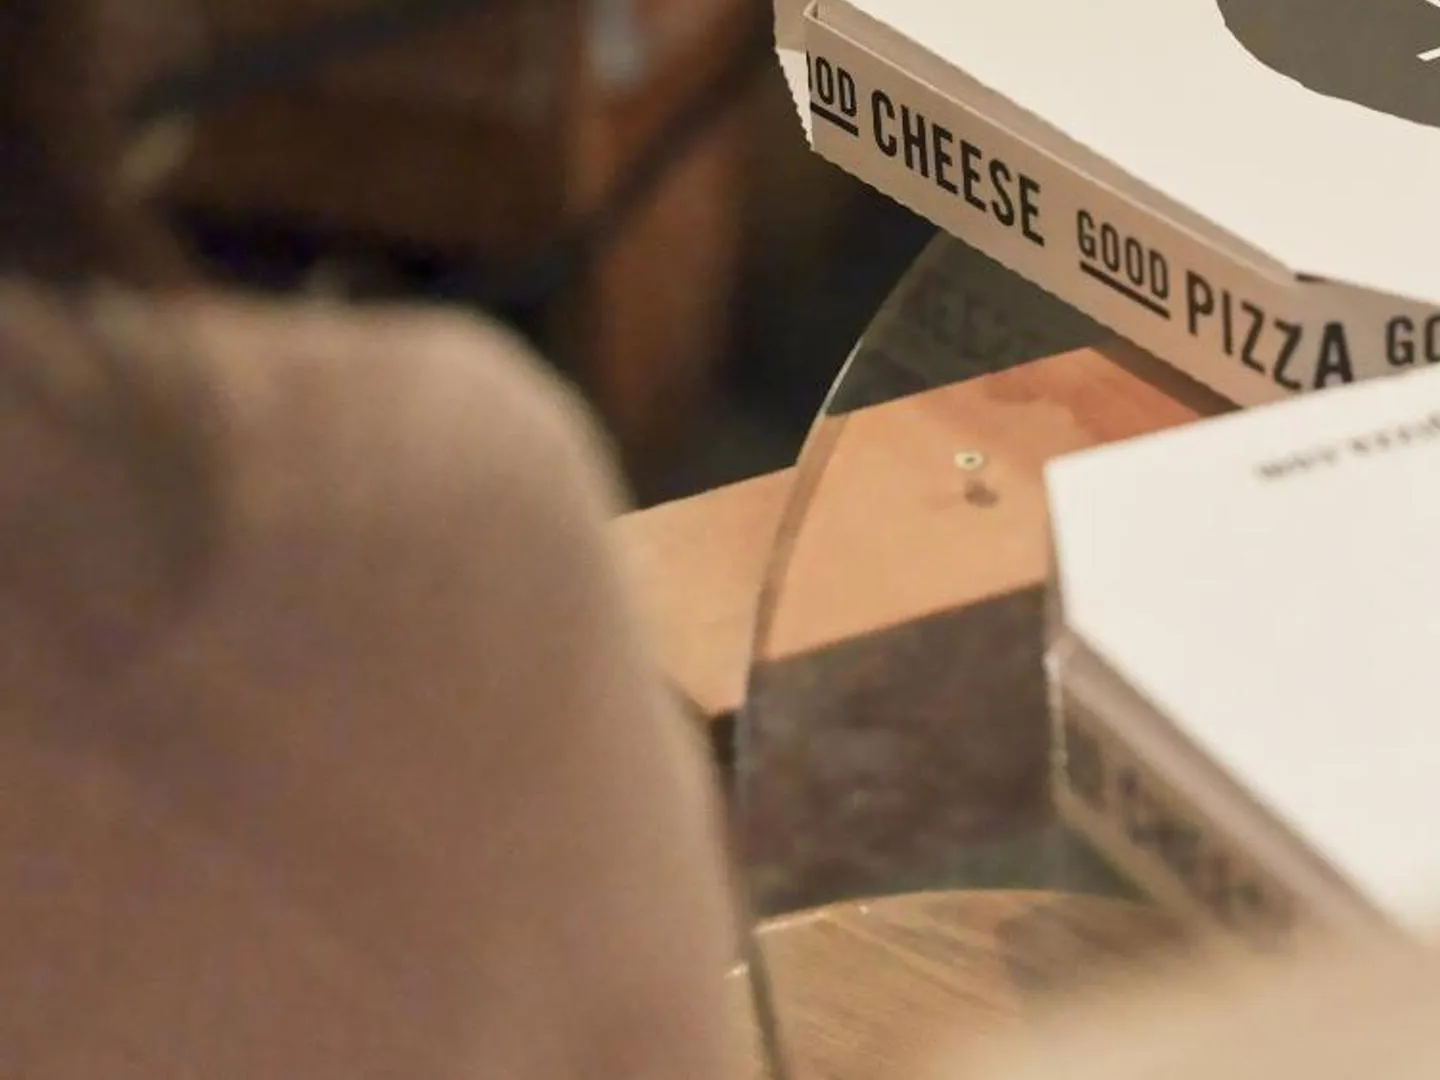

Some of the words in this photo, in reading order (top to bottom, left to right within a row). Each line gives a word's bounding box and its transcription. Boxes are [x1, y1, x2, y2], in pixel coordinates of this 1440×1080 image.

[806, 49, 857, 117] OD
[871, 89, 1045, 247] CHEESE
[1077, 210, 1170, 301] GOOD
[1186, 268, 1355, 392] PIZZA
